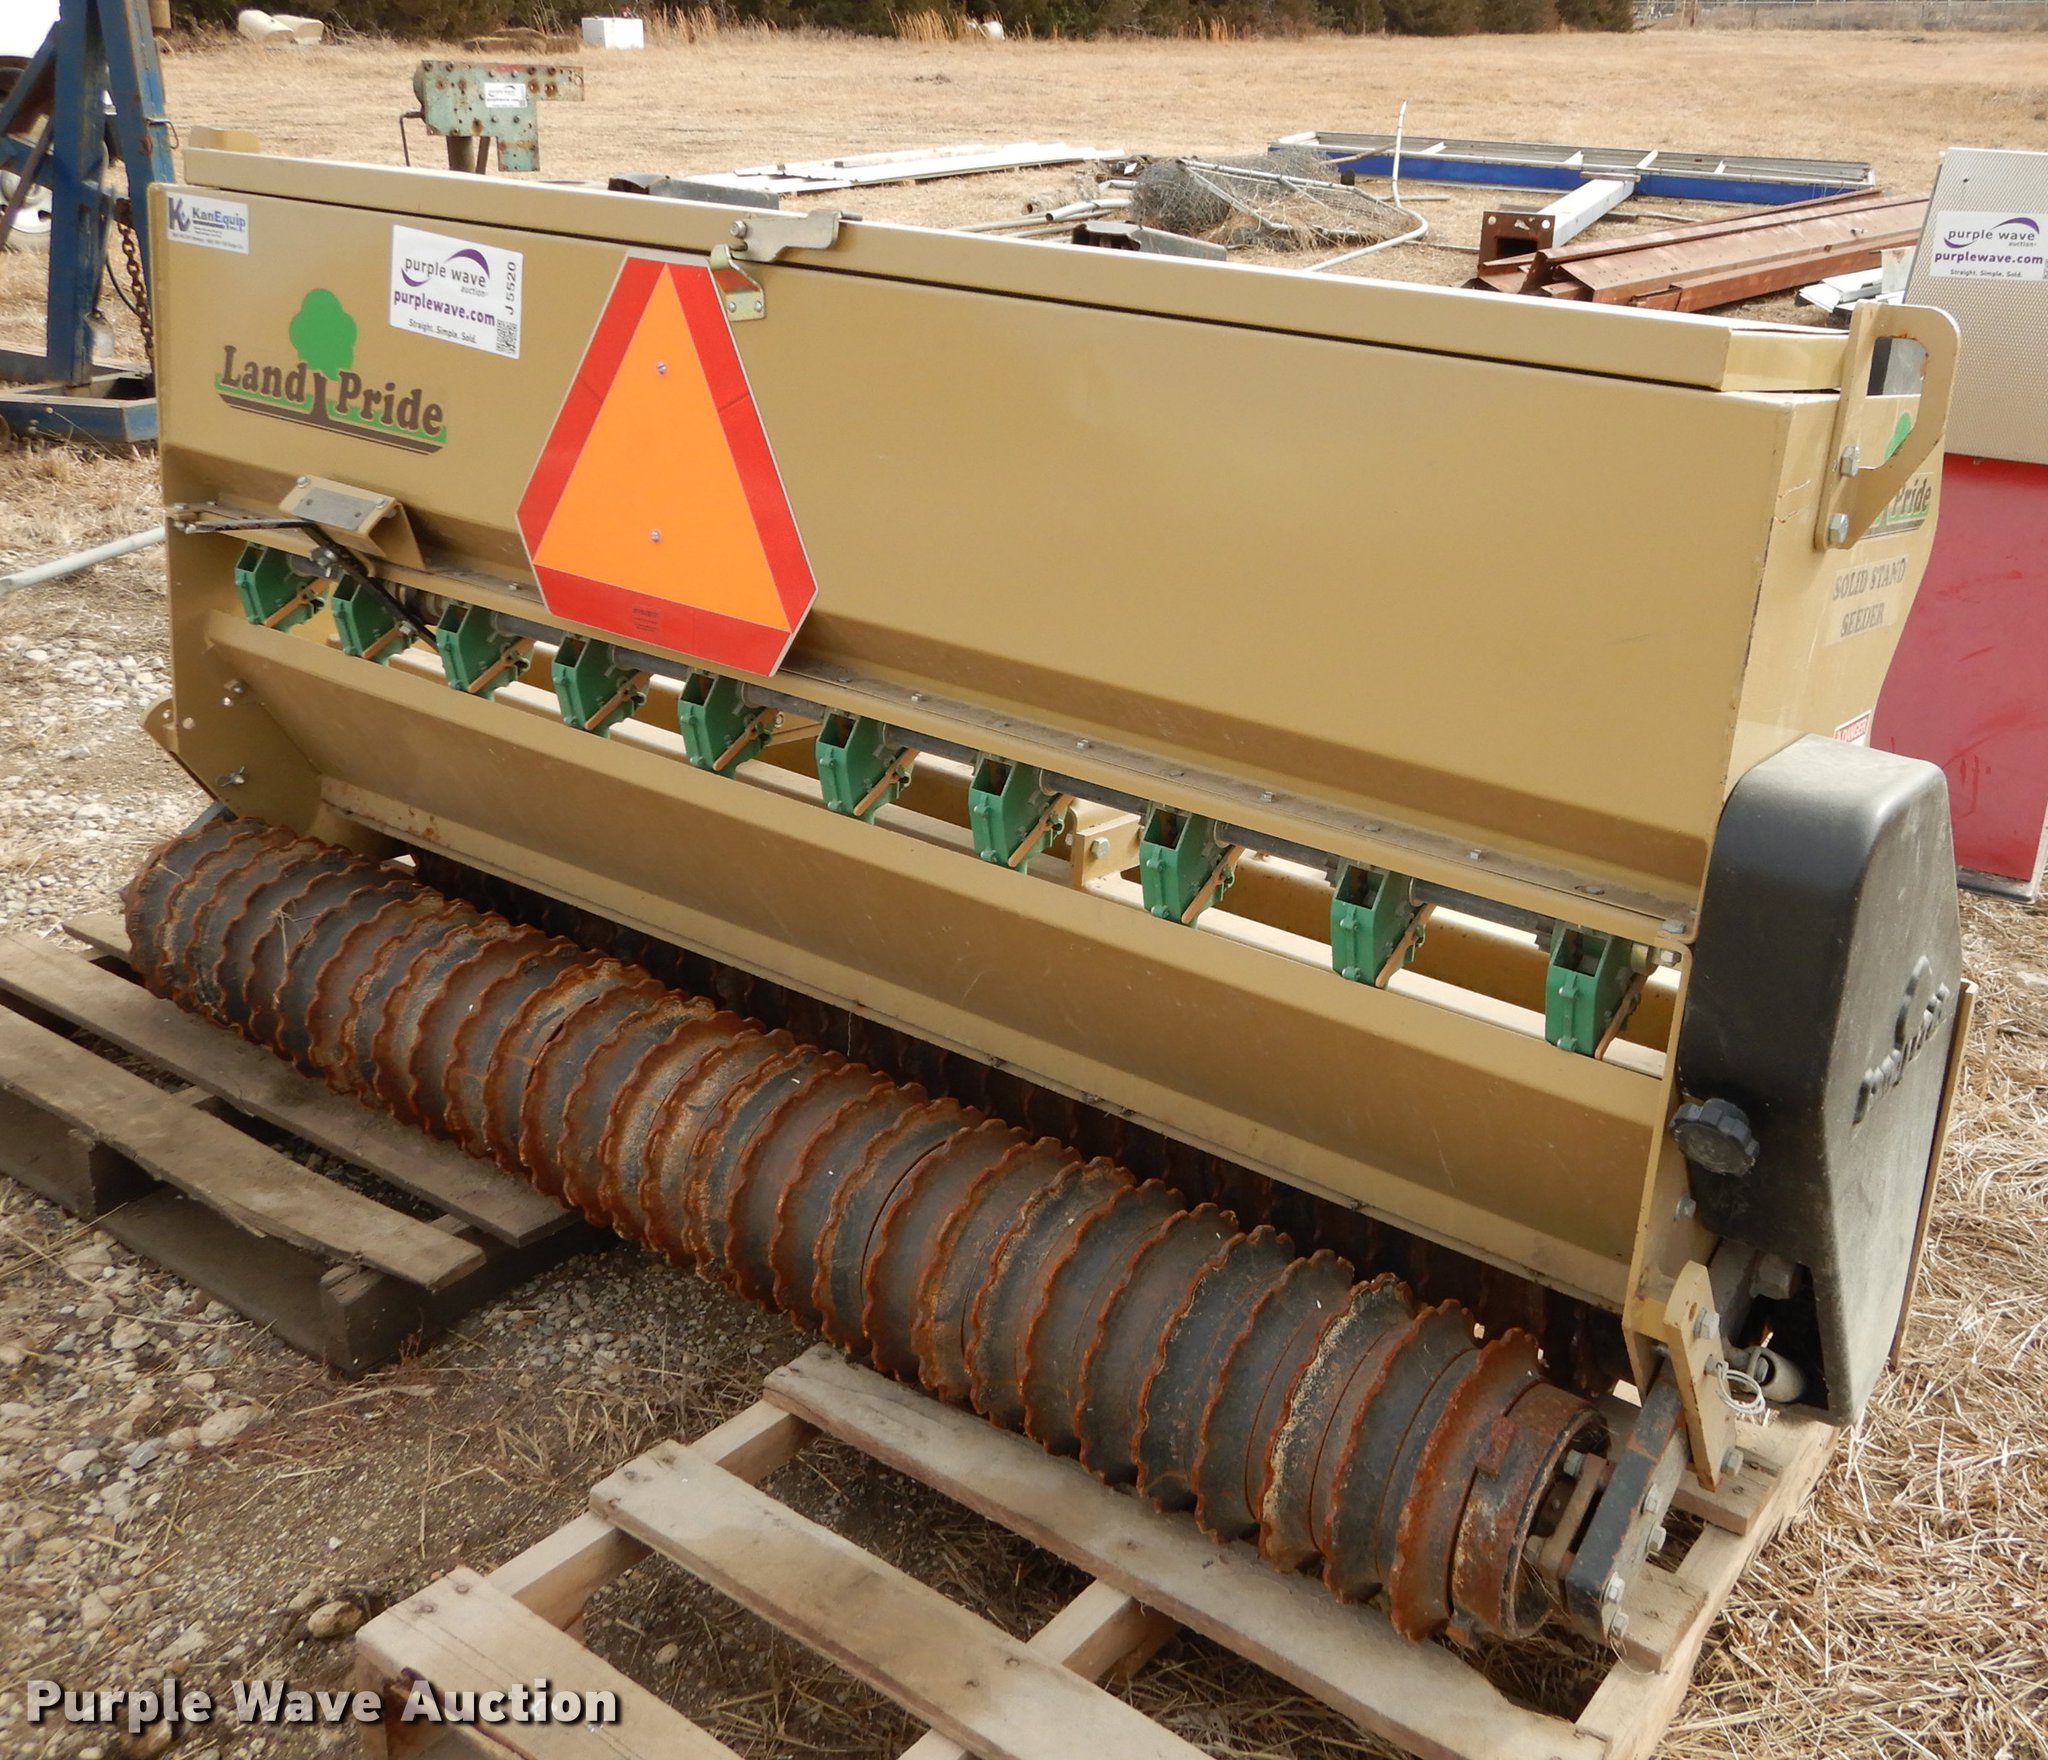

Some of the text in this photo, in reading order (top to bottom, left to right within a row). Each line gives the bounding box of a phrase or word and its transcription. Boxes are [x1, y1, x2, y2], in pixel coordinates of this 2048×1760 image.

[192, 207, 246, 231] KanEquip
[1948, 229, 2035, 241] purple wave
[404, 258, 486, 288] purple wave
[1934, 251, 2043, 264] purplewave.com
[393, 290, 496, 326] purplewave.com
[220, 345, 443, 436] Land Pride
[1833, 557, 1906, 601] SOLID STAND
[1840, 602, 1885, 638] SEEDER
